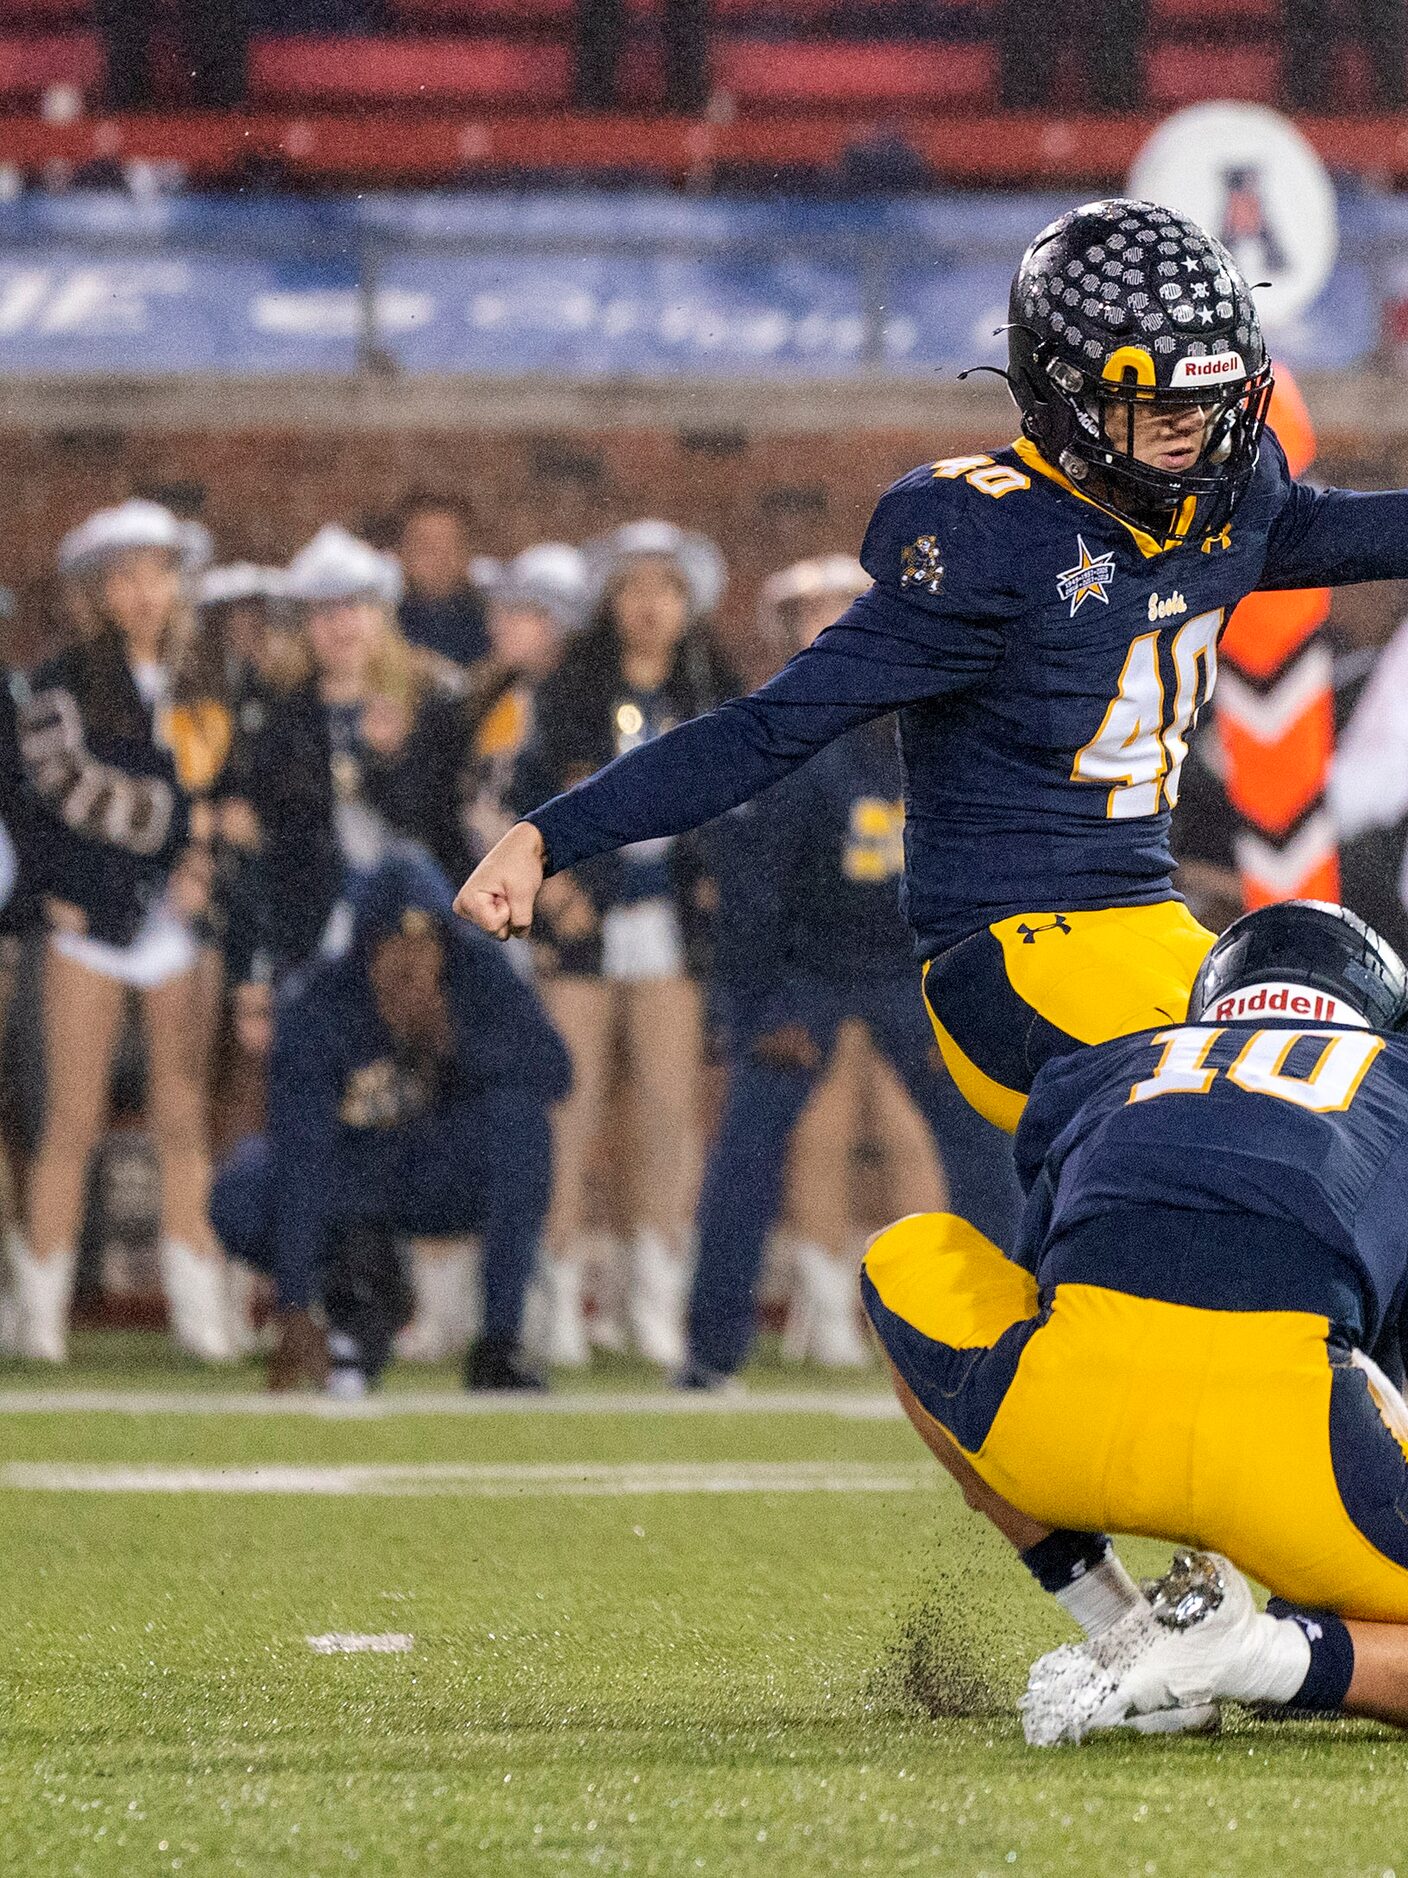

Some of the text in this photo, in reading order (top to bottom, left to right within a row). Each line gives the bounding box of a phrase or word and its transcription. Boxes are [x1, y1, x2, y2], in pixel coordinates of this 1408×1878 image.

[1122, 246, 1144, 263] PRIDE
[1101, 260, 1124, 277] PRIDE
[1122, 268, 1144, 286] PRIDE
[1099, 281, 1121, 301] PRIDE
[1126, 291, 1150, 310] PRIDE
[1140, 312, 1164, 332] PRIDE
[1083, 339, 1104, 359] PRIDE
[1154, 335, 1177, 354] PRIDE
[1185, 356, 1238, 377] Riddell
[929, 453, 1032, 500] 40
[1069, 607, 1225, 819] 40
[1215, 989, 1337, 1023] Riddell
[1125, 1026, 1387, 1113] 10
